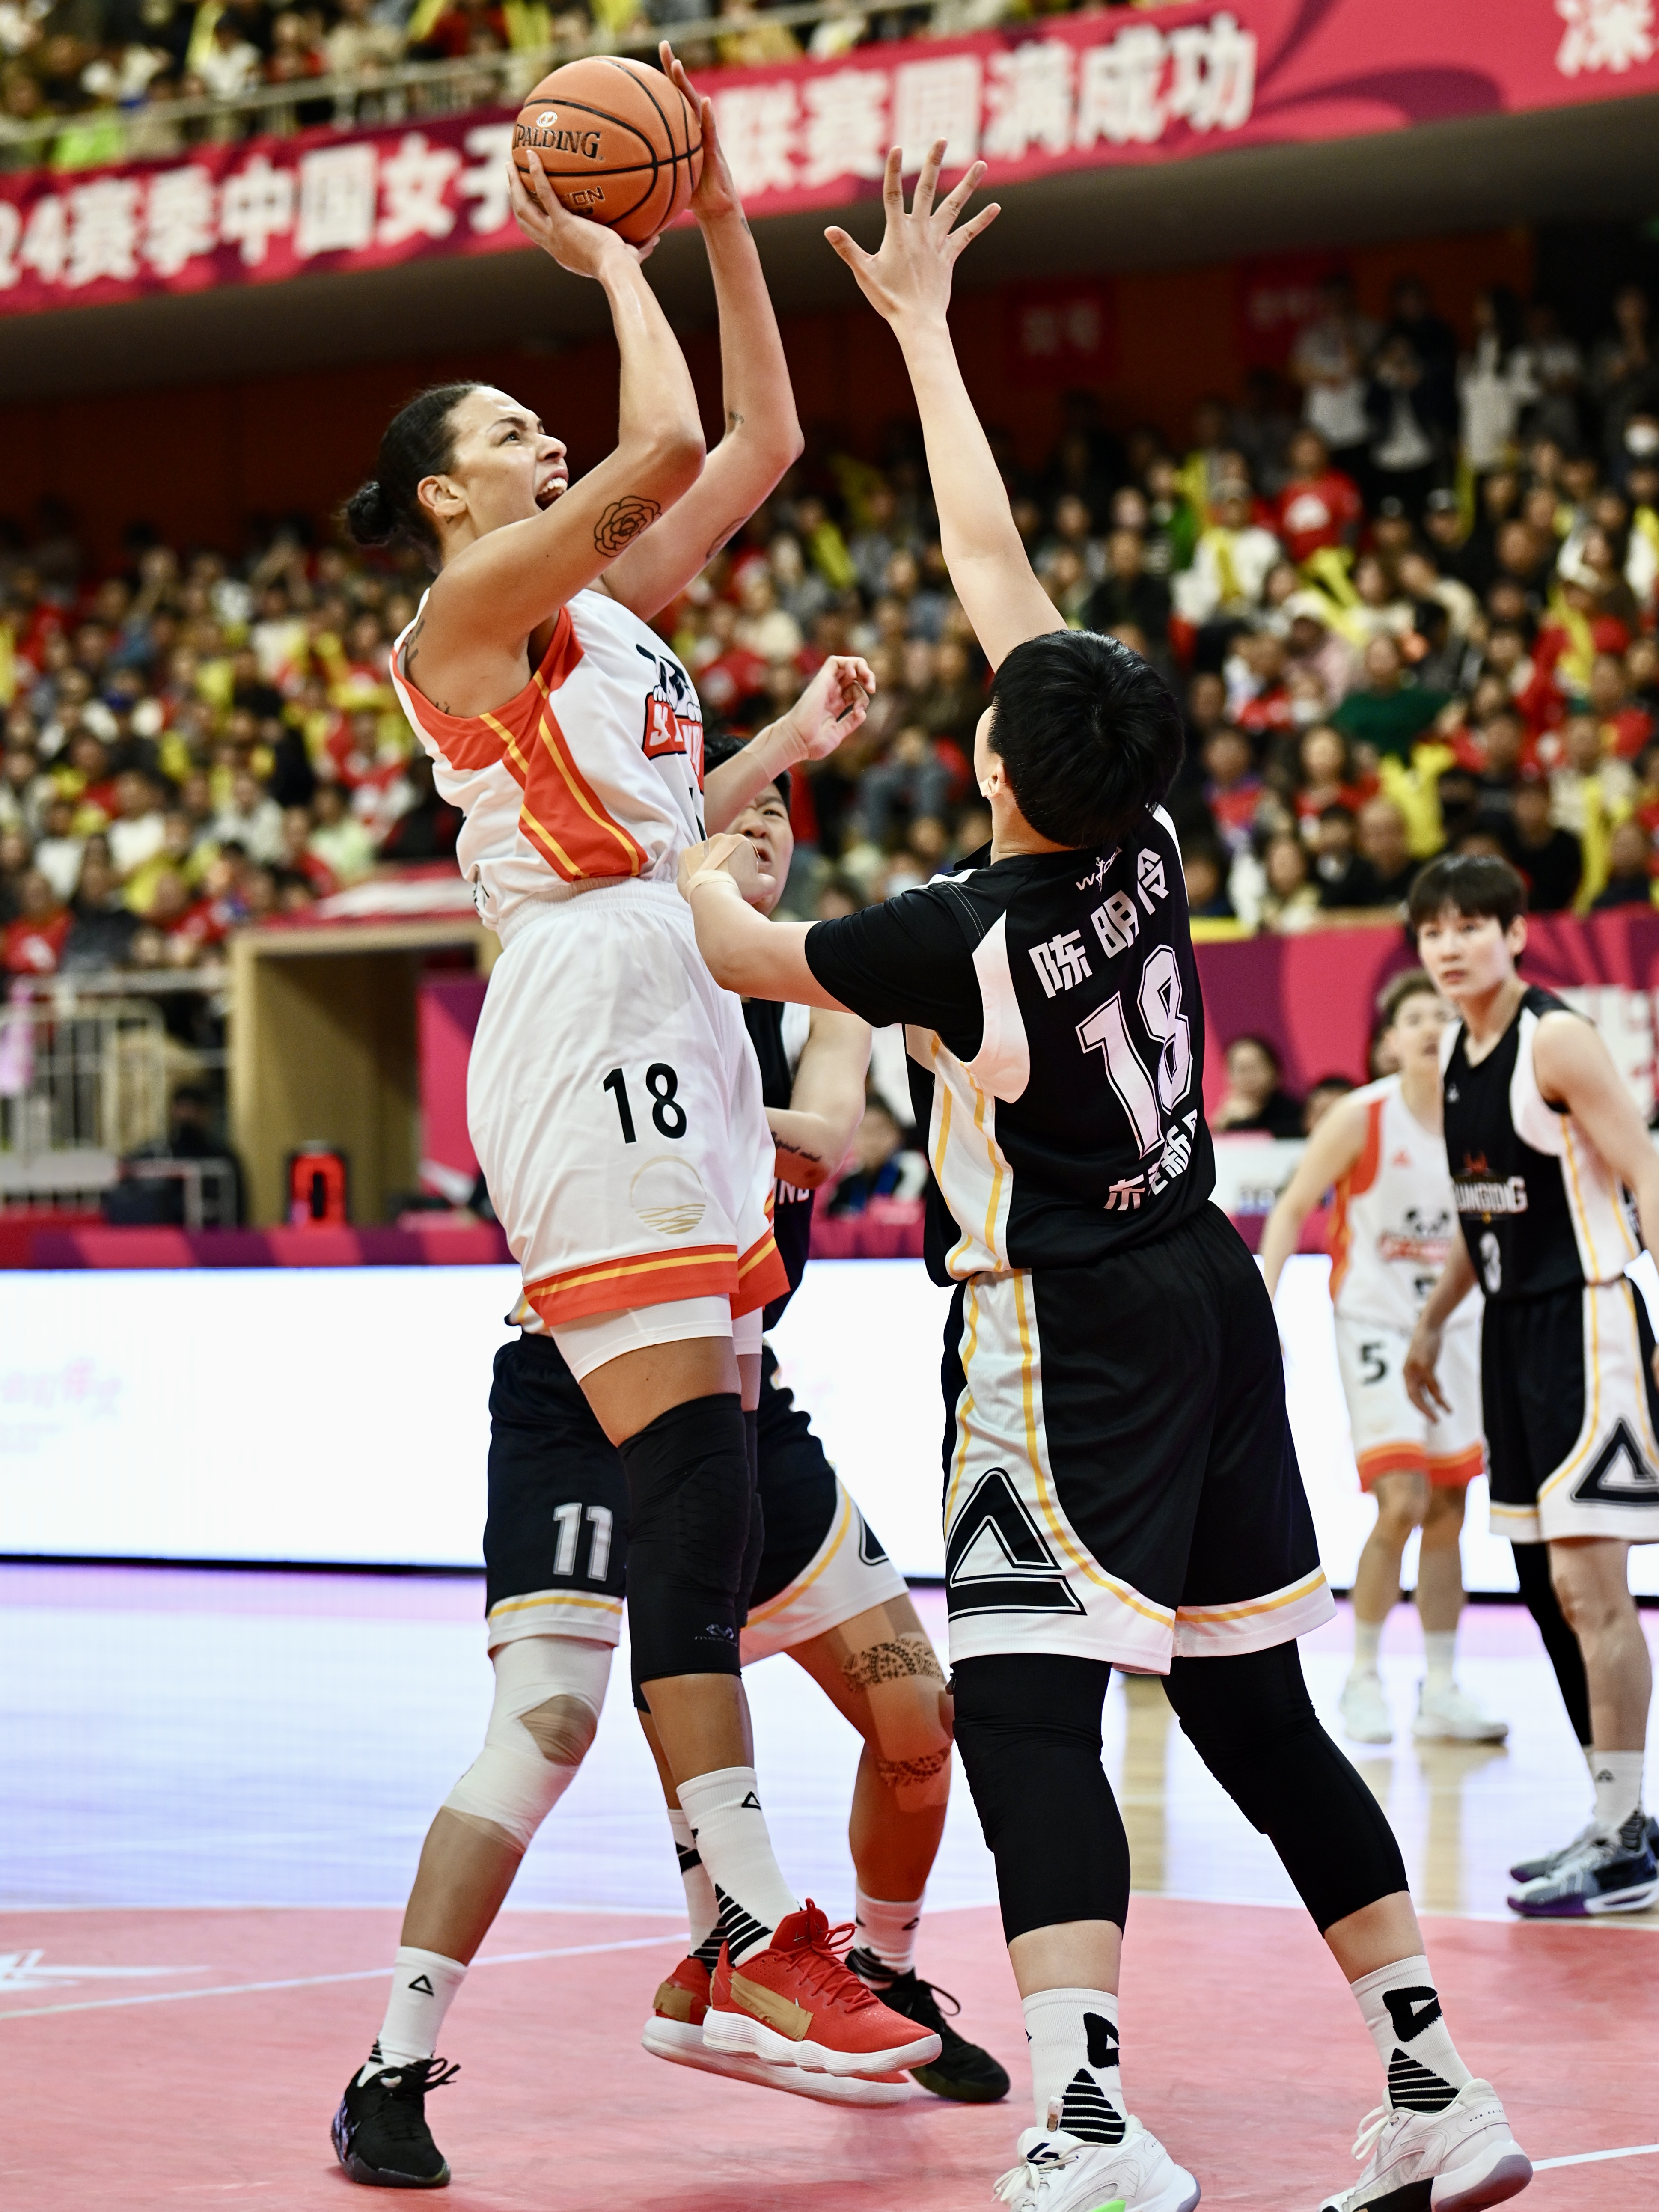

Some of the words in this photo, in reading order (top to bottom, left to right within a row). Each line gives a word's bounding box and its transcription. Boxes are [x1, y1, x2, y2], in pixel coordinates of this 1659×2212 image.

[1075, 944, 1193, 1160] 18
[603, 1062, 687, 1144] 18
[1360, 1342, 1388, 1385] 5
[553, 1502, 613, 1582] 11
